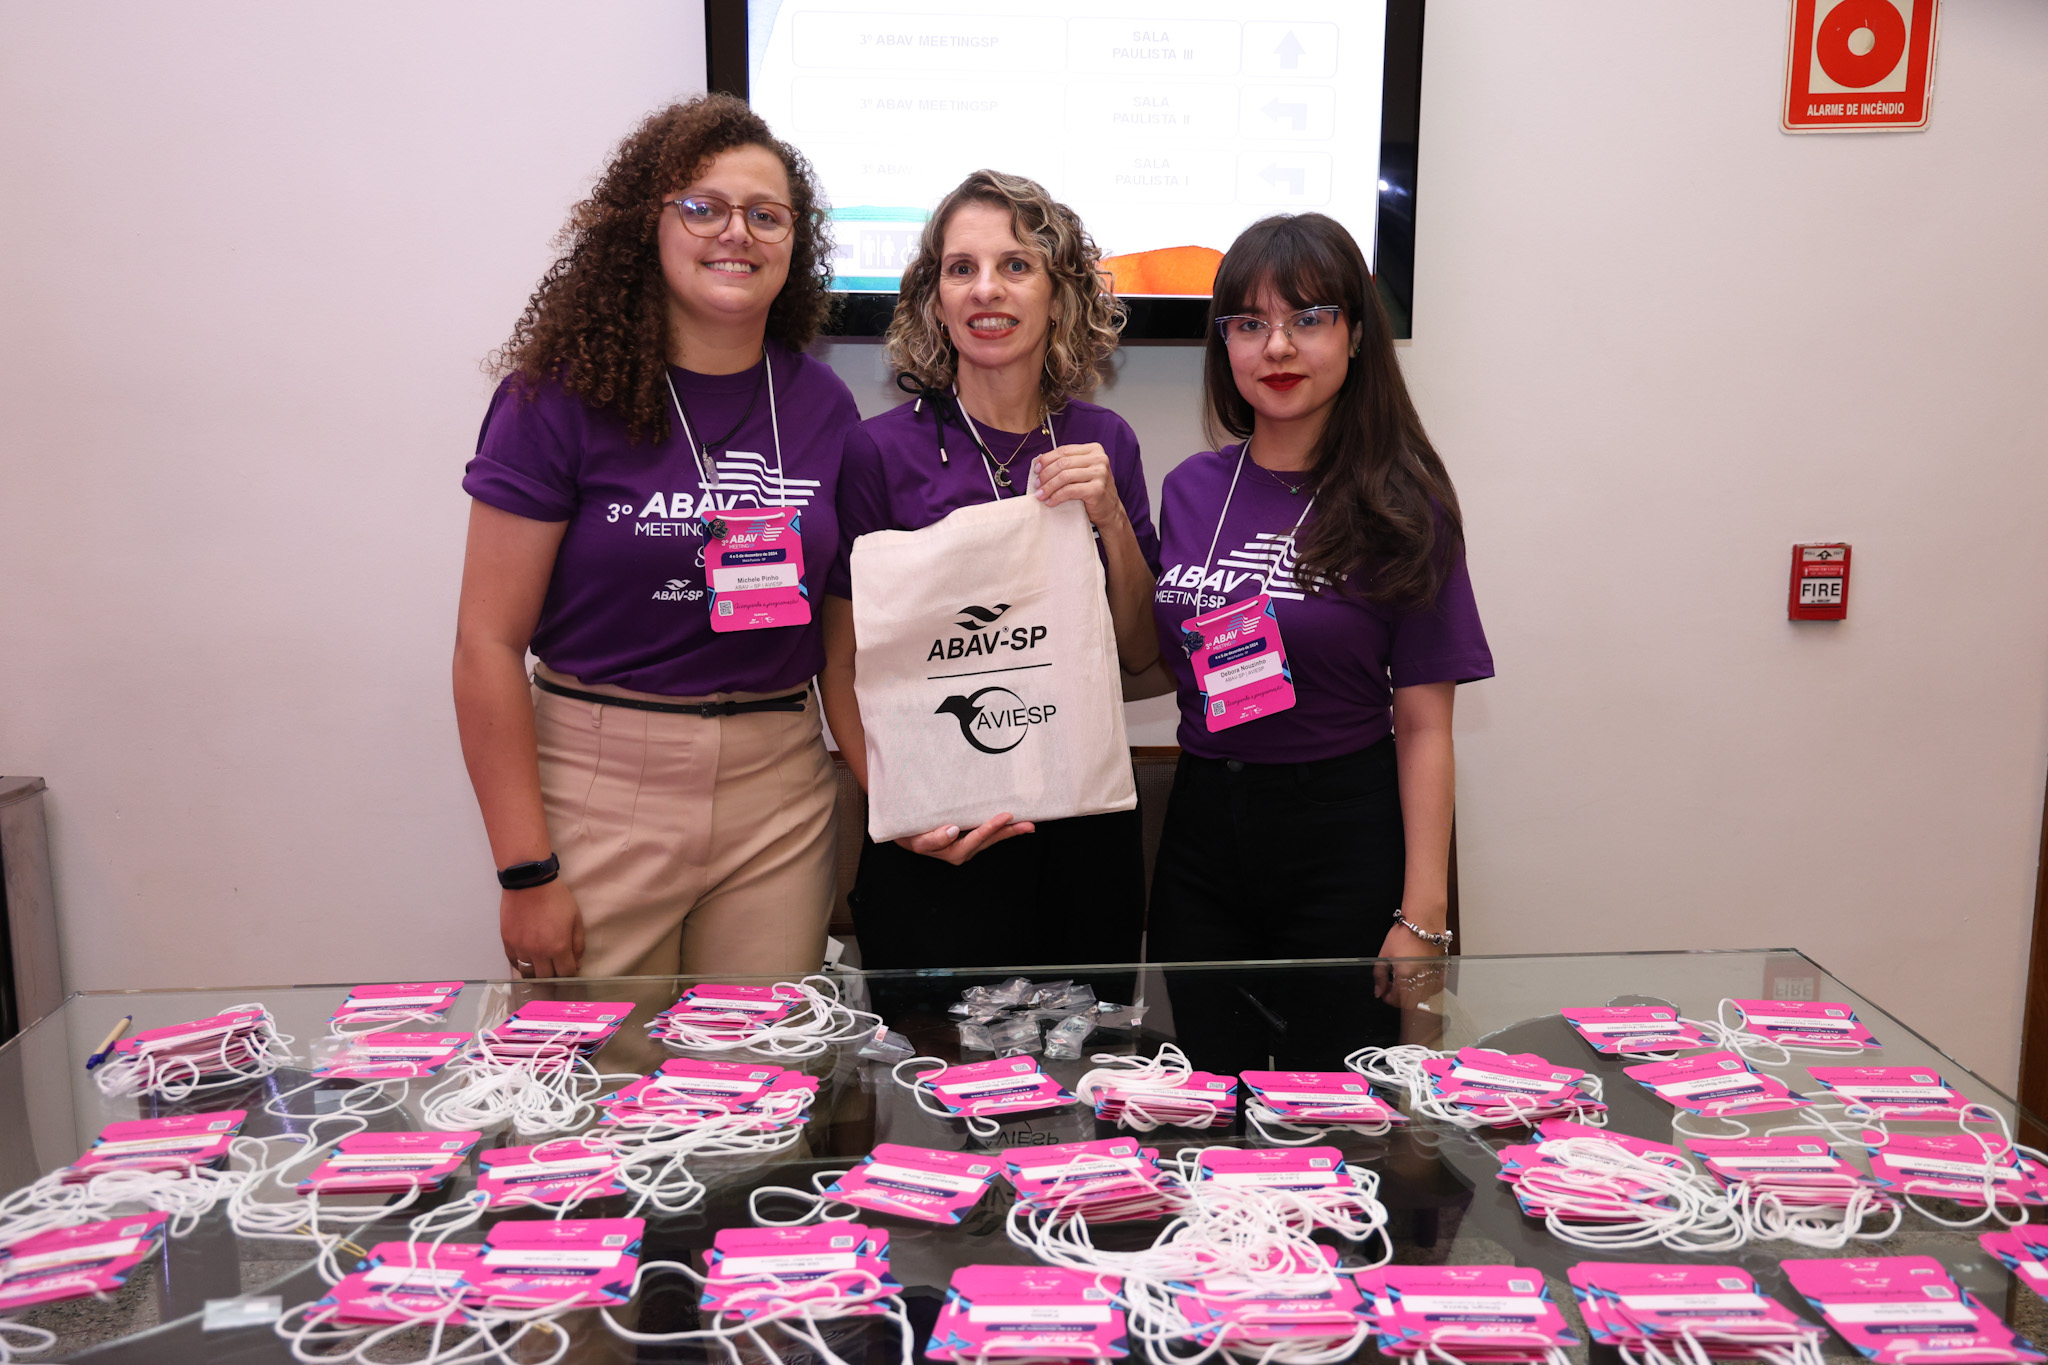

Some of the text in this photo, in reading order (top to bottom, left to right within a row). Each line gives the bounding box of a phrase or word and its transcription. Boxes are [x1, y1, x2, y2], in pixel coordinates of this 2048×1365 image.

[876, 34, 913, 48] ABAV
[918, 35, 999, 49] MEETINGSP
[1132, 31, 1170, 43] SALA
[1112, 48, 1194, 61] PAULISTA III
[876, 98, 914, 112] ABAV
[918, 99, 999, 112] MEETINGSP
[1132, 96, 1170, 108] SALA
[1807, 100, 1904, 116] ALARME DE INCÊNDIO
[1112, 112, 1190, 125] PAULISTA II
[1134, 158, 1170, 170] SALA
[1114, 174, 1178, 186] PAULISTA
[606, 492, 739, 523] 3º ABAV
[730, 534, 758, 544] ABAV
[1160, 564, 1252, 594] ABAV
[652, 590, 704, 601] ABAV-SP
[1802, 583, 1840, 596] FIRE
[1154, 590, 1226, 609] MEETINGSP
[1213, 630, 1238, 646] ABAV
[1221, 668, 1240, 678] Debora
[977, 705, 1057, 730] AVIESP
